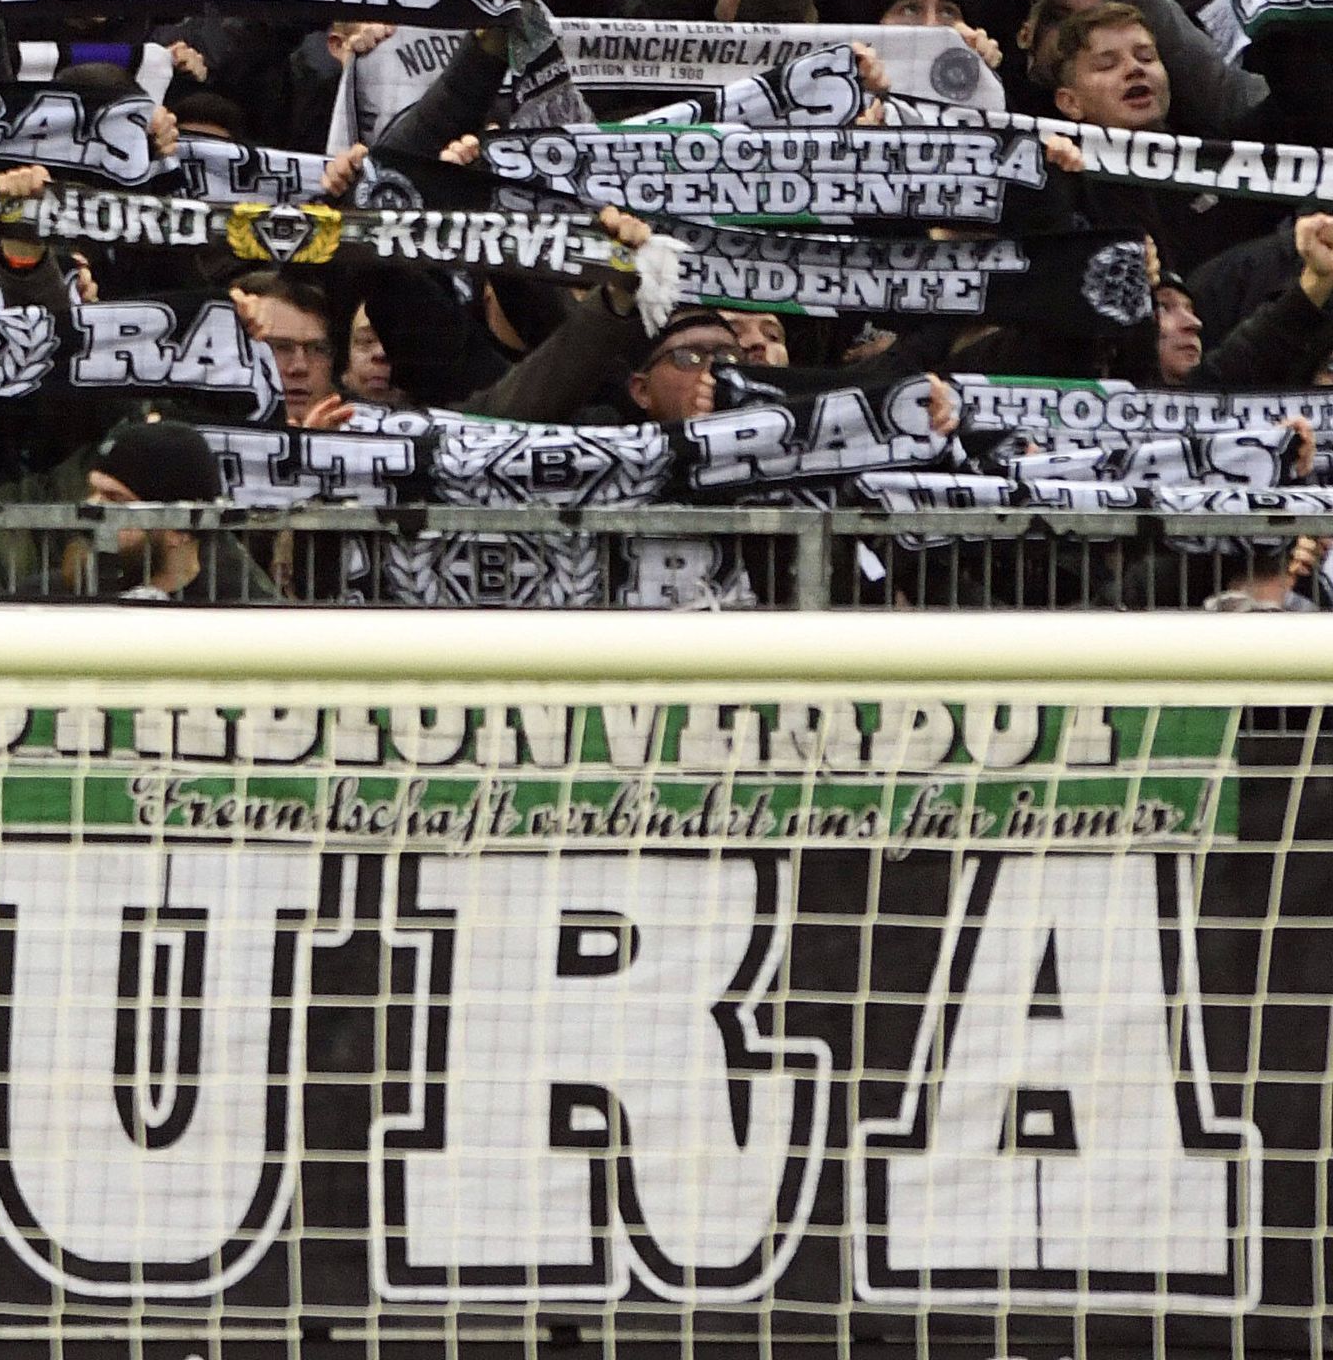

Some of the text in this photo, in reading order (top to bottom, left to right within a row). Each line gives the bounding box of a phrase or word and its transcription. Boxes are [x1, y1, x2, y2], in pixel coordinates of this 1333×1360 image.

[669, 67, 705, 80] 1900
[486, 129, 1047, 189] SOTTOCULTURA
[37, 188, 211, 247] NORD
